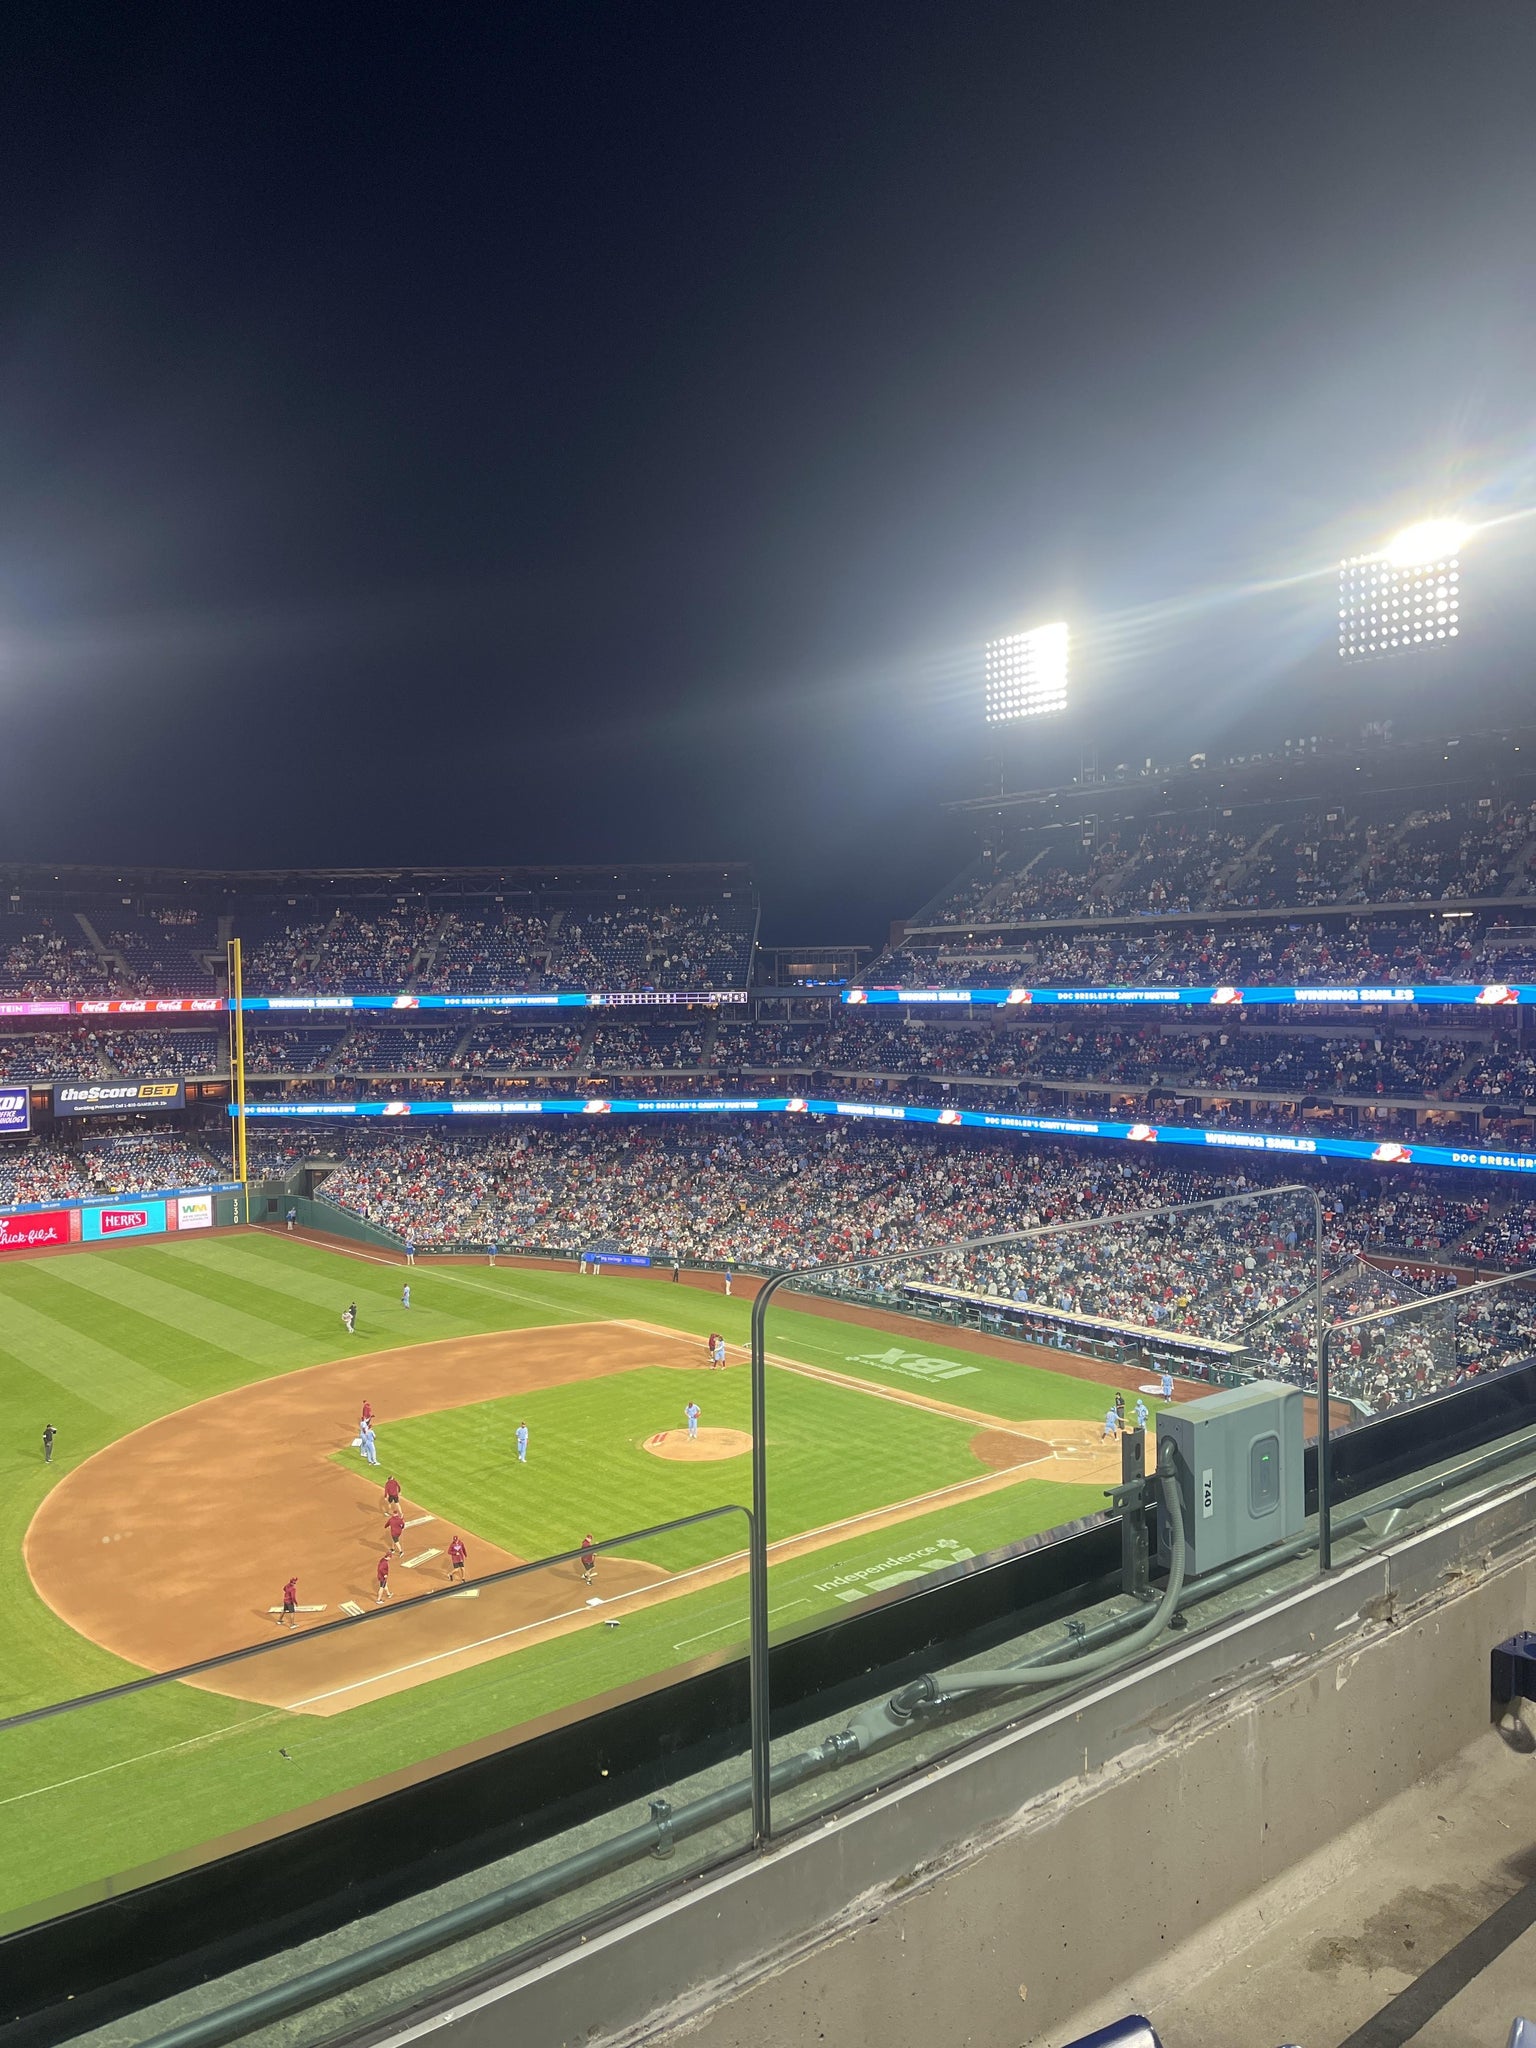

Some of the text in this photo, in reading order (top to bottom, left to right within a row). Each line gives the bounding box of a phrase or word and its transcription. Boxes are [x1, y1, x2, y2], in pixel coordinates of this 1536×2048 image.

[898, 992, 972, 1001] WINNING SMILES
[1294, 989, 1414, 1000] WINNING SMILES
[60, 1085, 176, 1101] theScore BET
[452, 1103, 542, 1112] WINNING SMILES
[837, 1104, 905, 1118] WINNING SMILES
[984, 1116, 1000, 1124] DOC
[1205, 1132, 1316, 1152] WINNING SMILES
[1452, 1152, 1477, 1164] DOC
[182, 1204, 208, 1214] WM
[105, 1213, 142, 1227] HERR'S
[1204, 1480, 1212, 1508] 740
[814, 1545, 939, 1592] Independence
